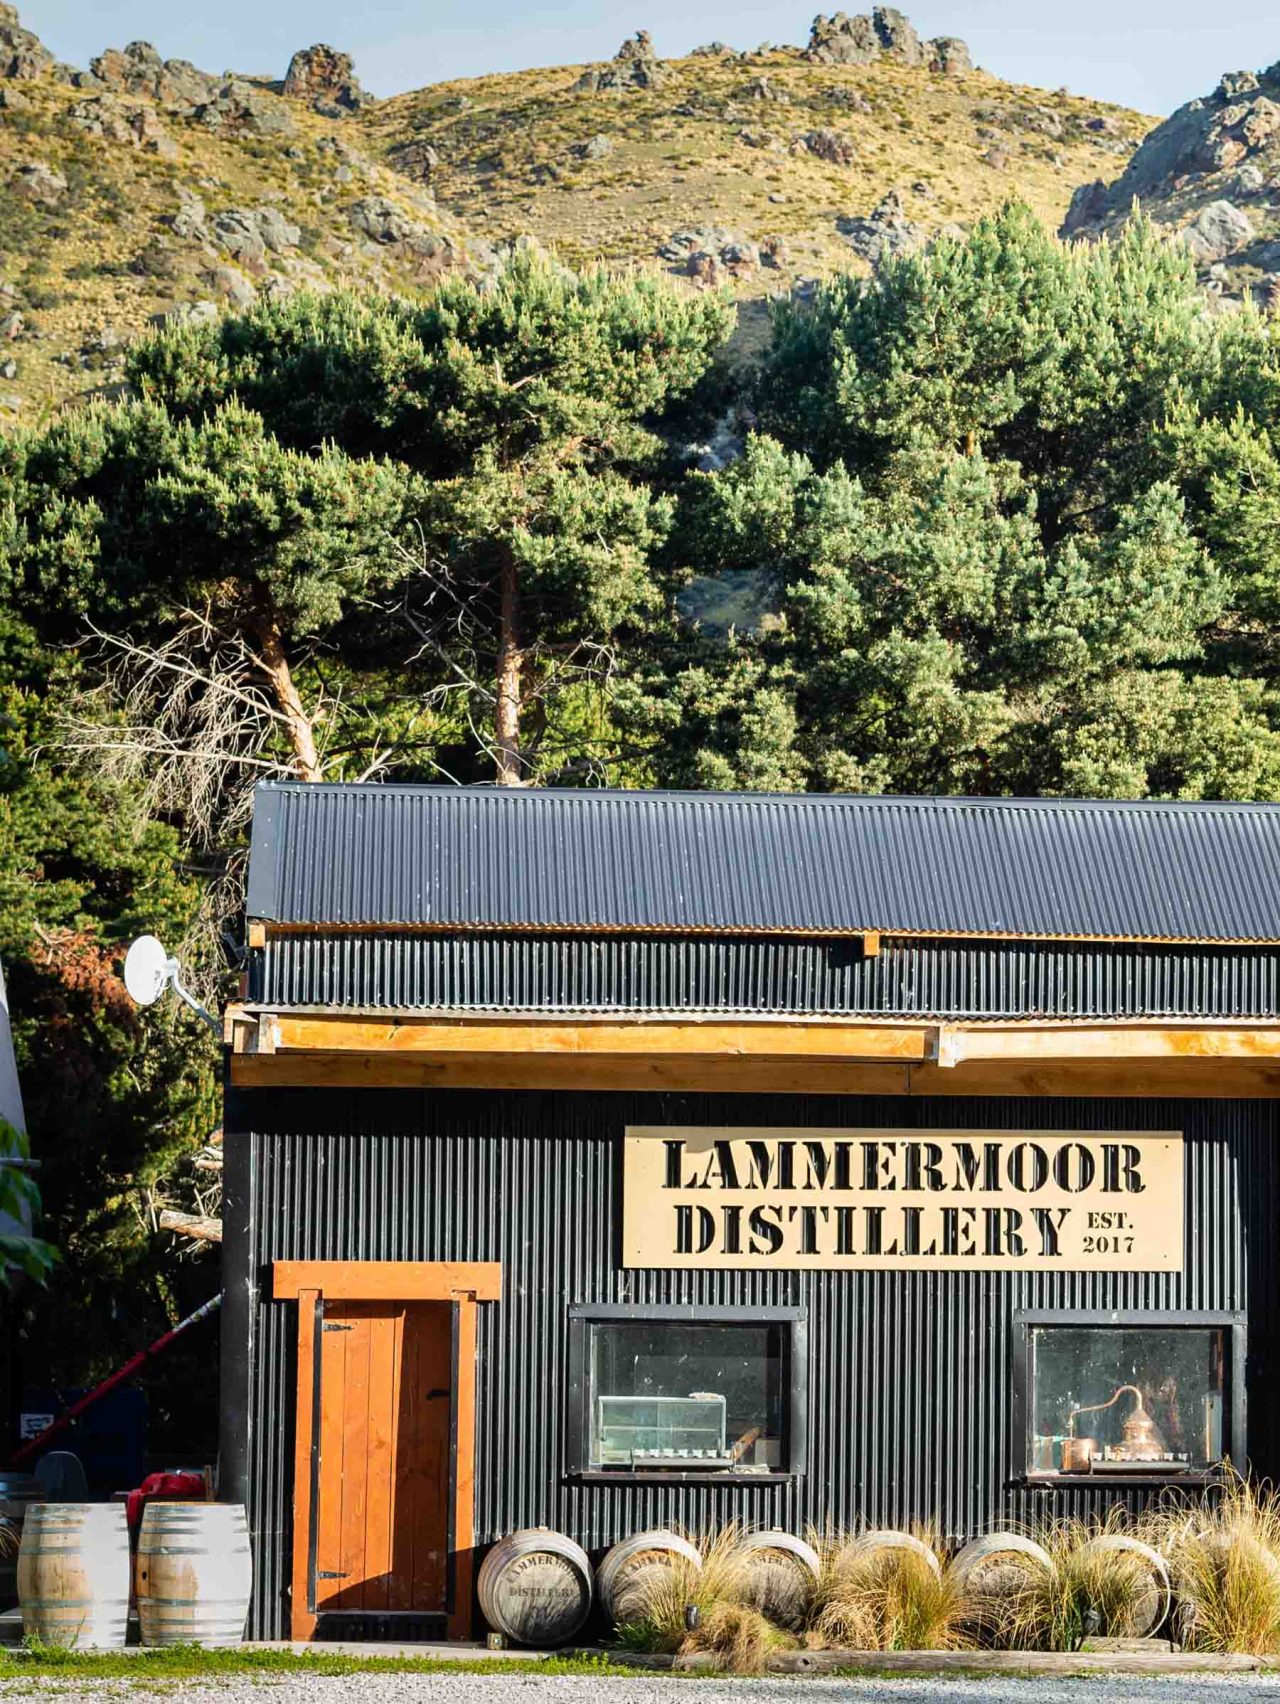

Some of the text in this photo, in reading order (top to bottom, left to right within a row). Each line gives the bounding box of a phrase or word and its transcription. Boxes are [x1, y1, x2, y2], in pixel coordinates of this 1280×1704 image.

[662, 1140, 1146, 1193] LAMMERMOOR
[673, 1205, 1071, 1257] DISTILLERY
[1087, 1212, 1134, 1229] EST.
[1083, 1236, 1135, 1253] 2017
